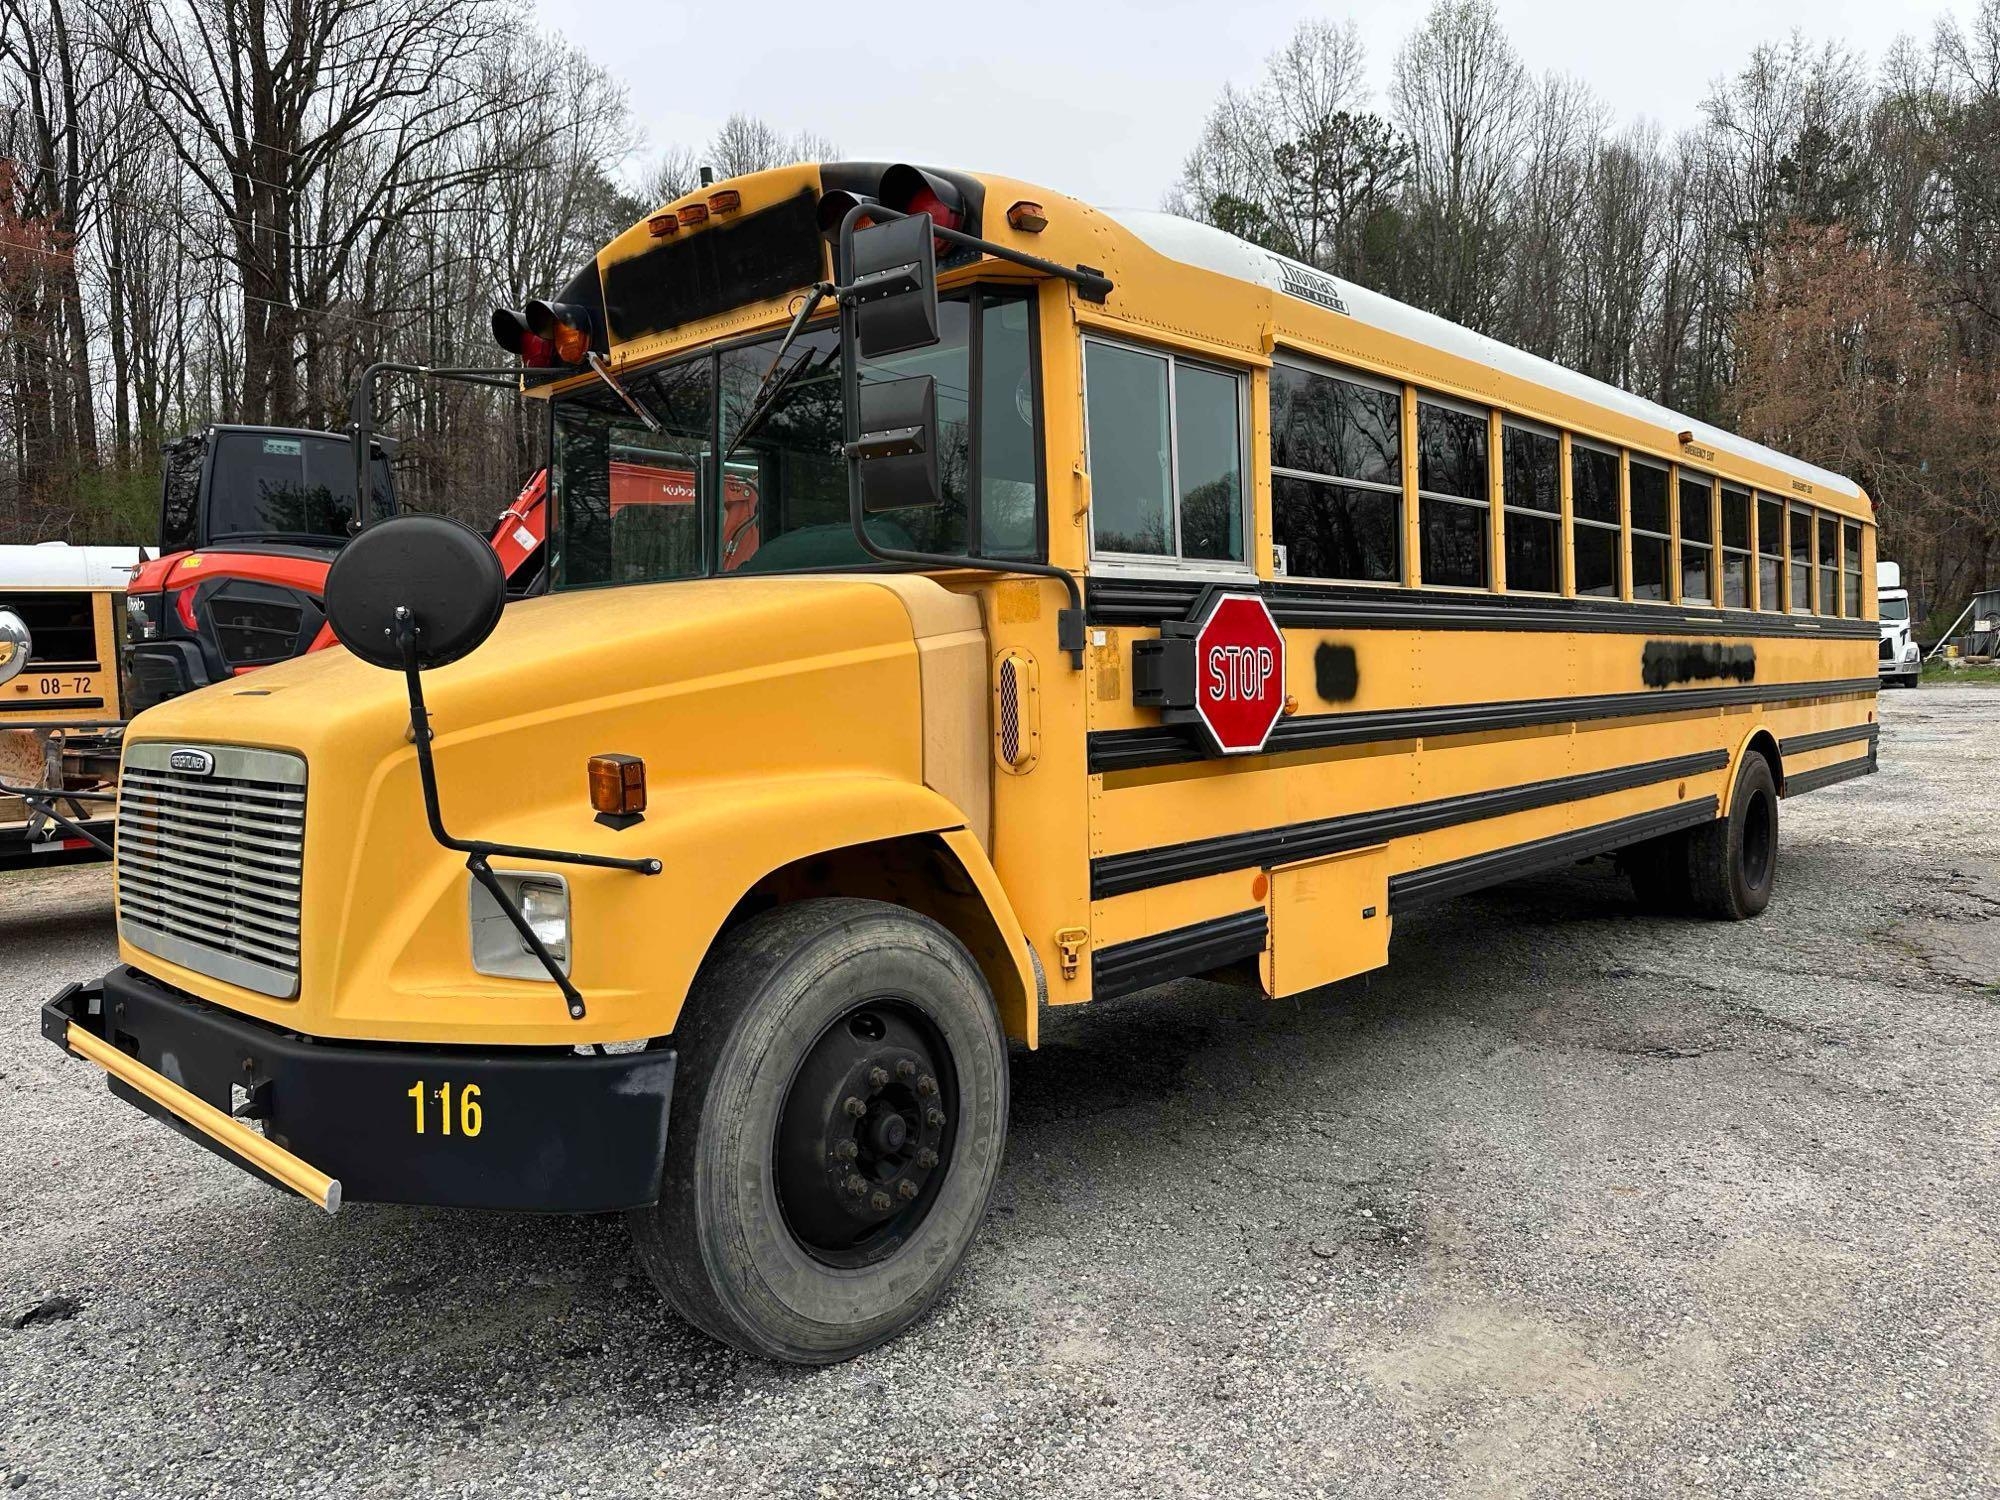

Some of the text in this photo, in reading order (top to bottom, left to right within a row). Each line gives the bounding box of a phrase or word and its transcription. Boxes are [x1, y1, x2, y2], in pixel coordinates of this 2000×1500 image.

[1265, 254, 1338, 297] Thomas
[1285, 281, 1311, 298] BUILT
[41, 677, 91, 695] 08-72
[1209, 645, 1274, 701] STOP
[408, 1080, 482, 1137] 116
